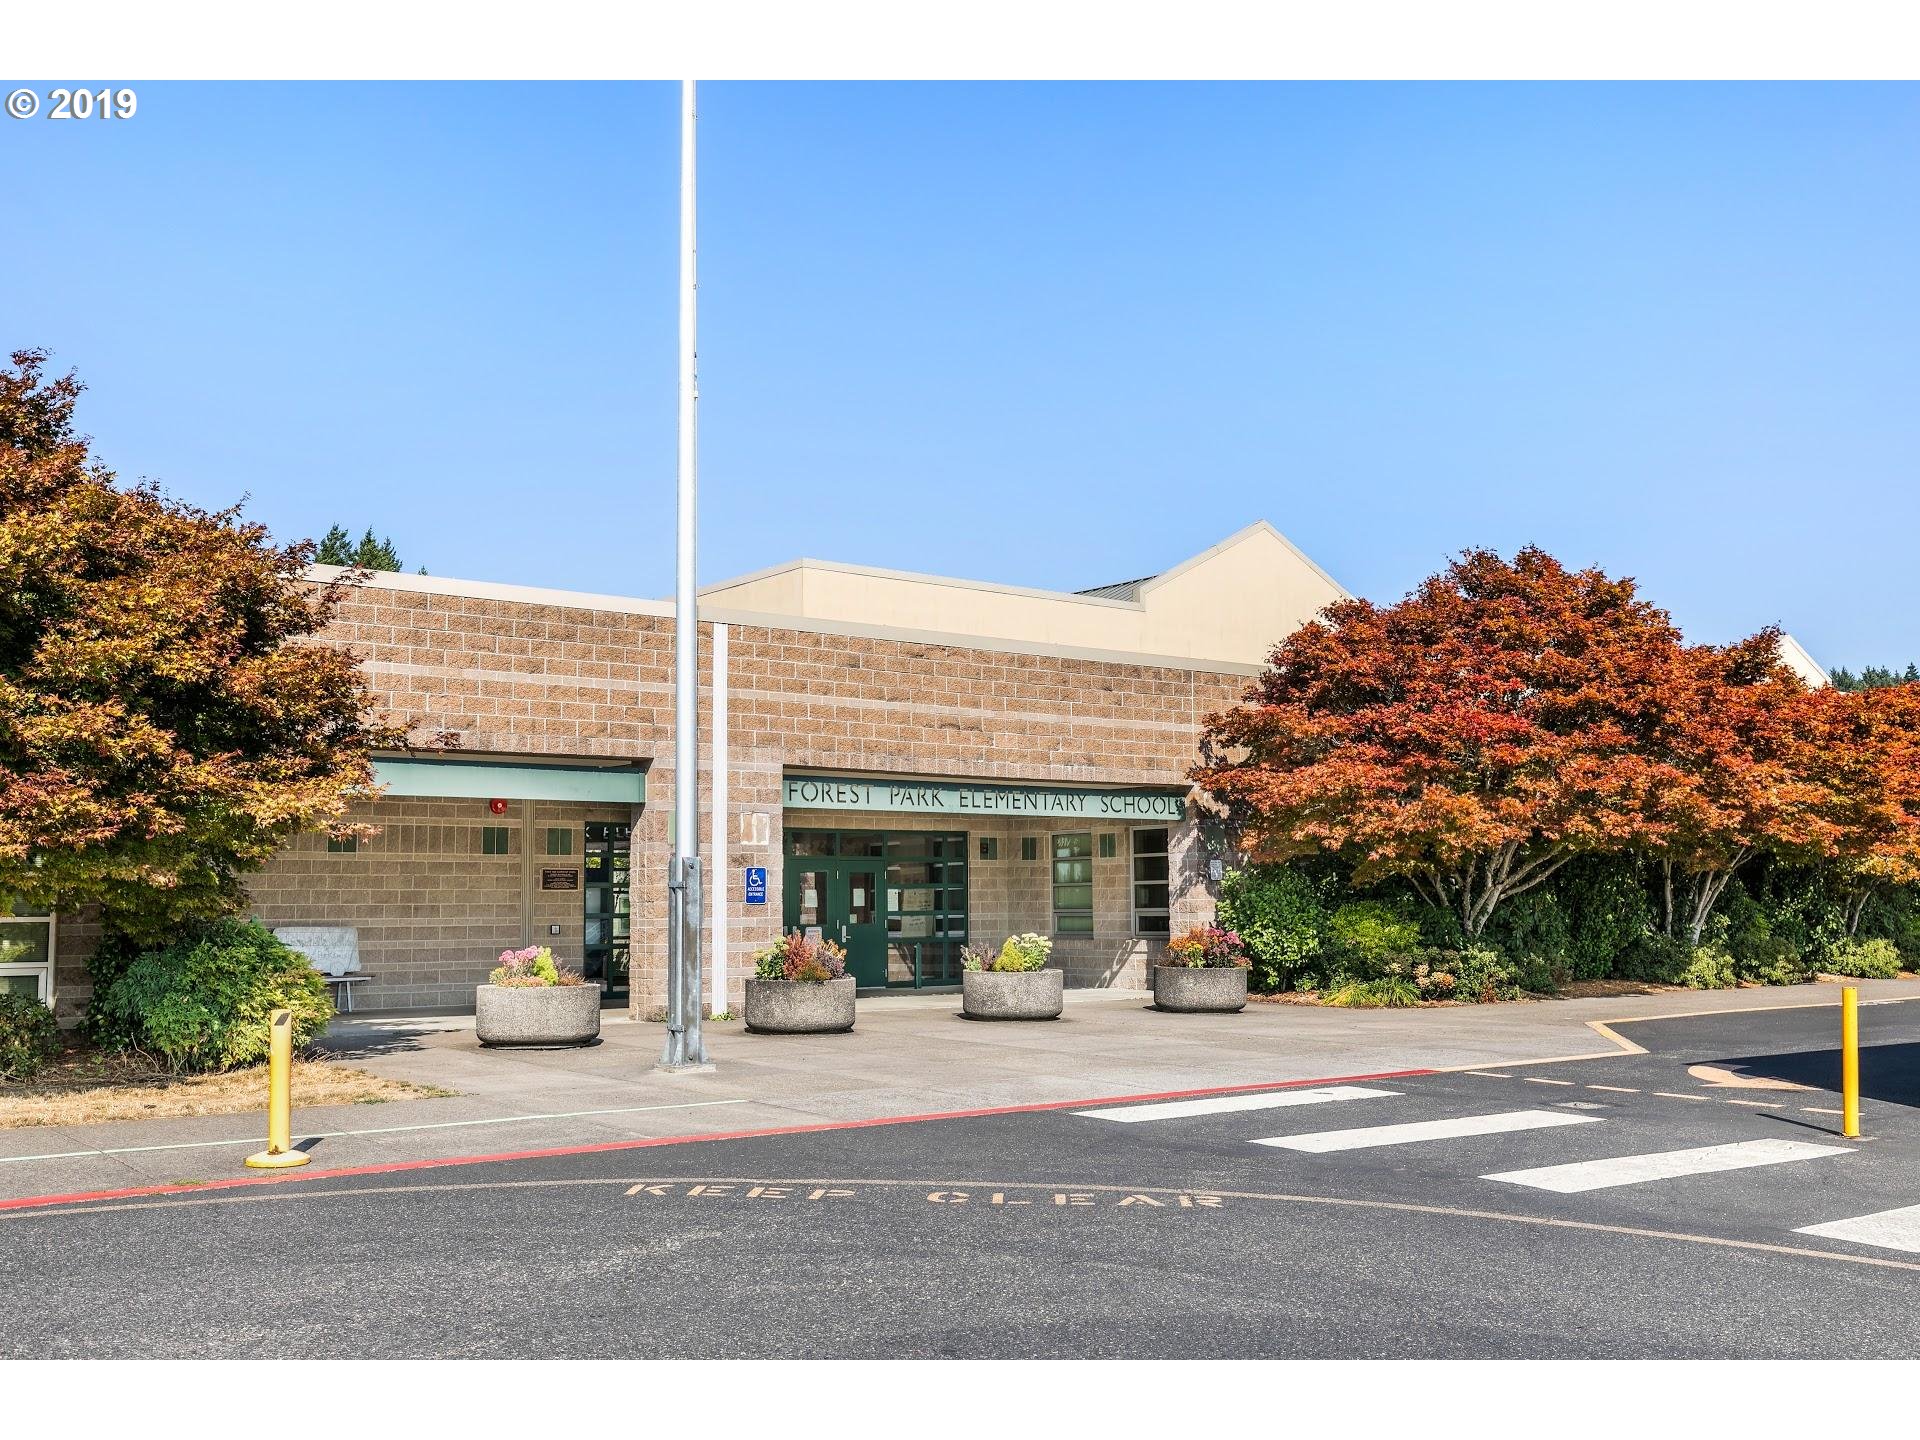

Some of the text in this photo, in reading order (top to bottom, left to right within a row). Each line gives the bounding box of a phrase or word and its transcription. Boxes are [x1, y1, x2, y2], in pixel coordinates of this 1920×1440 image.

[788, 781, 1177, 815] FOREST PARK ELEMENTARY SCHOOL
[623, 1184, 1225, 1208] KEEP CLEAR
